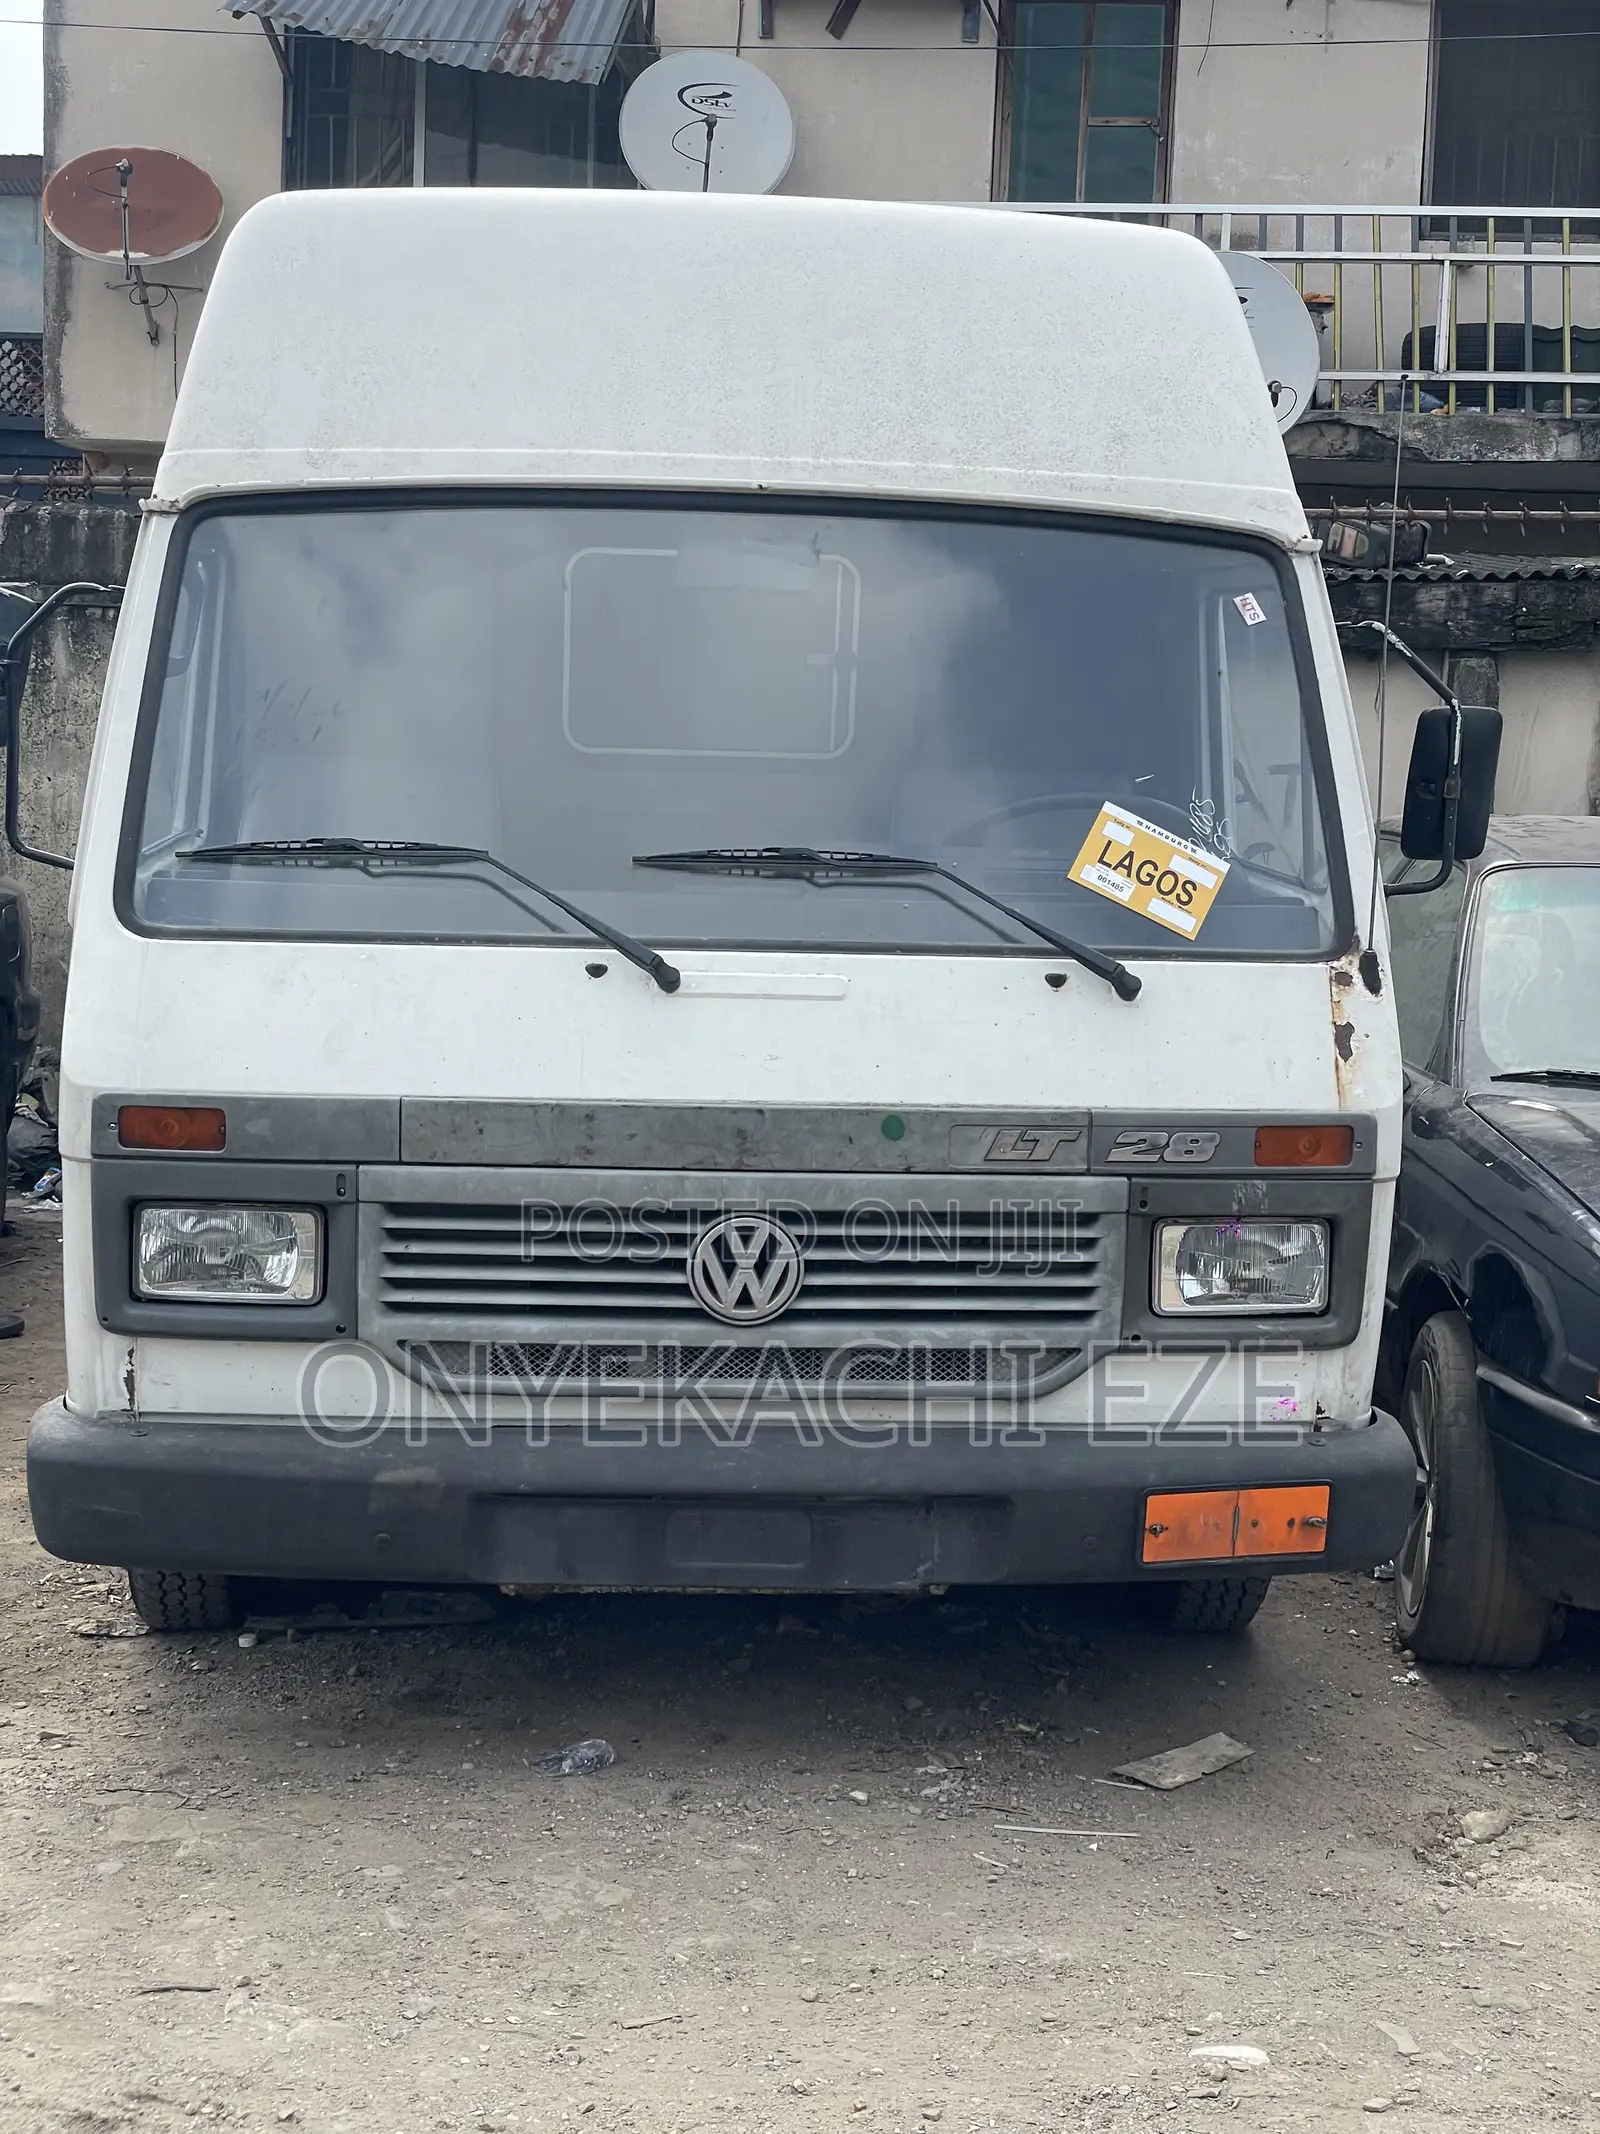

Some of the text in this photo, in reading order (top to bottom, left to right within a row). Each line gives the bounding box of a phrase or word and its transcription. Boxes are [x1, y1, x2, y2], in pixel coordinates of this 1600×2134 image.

[1145, 825, 1189, 850] HAMBURG
[1097, 839, 1198, 907] LAGOS
[984, 1129, 1221, 1163] LT 28
